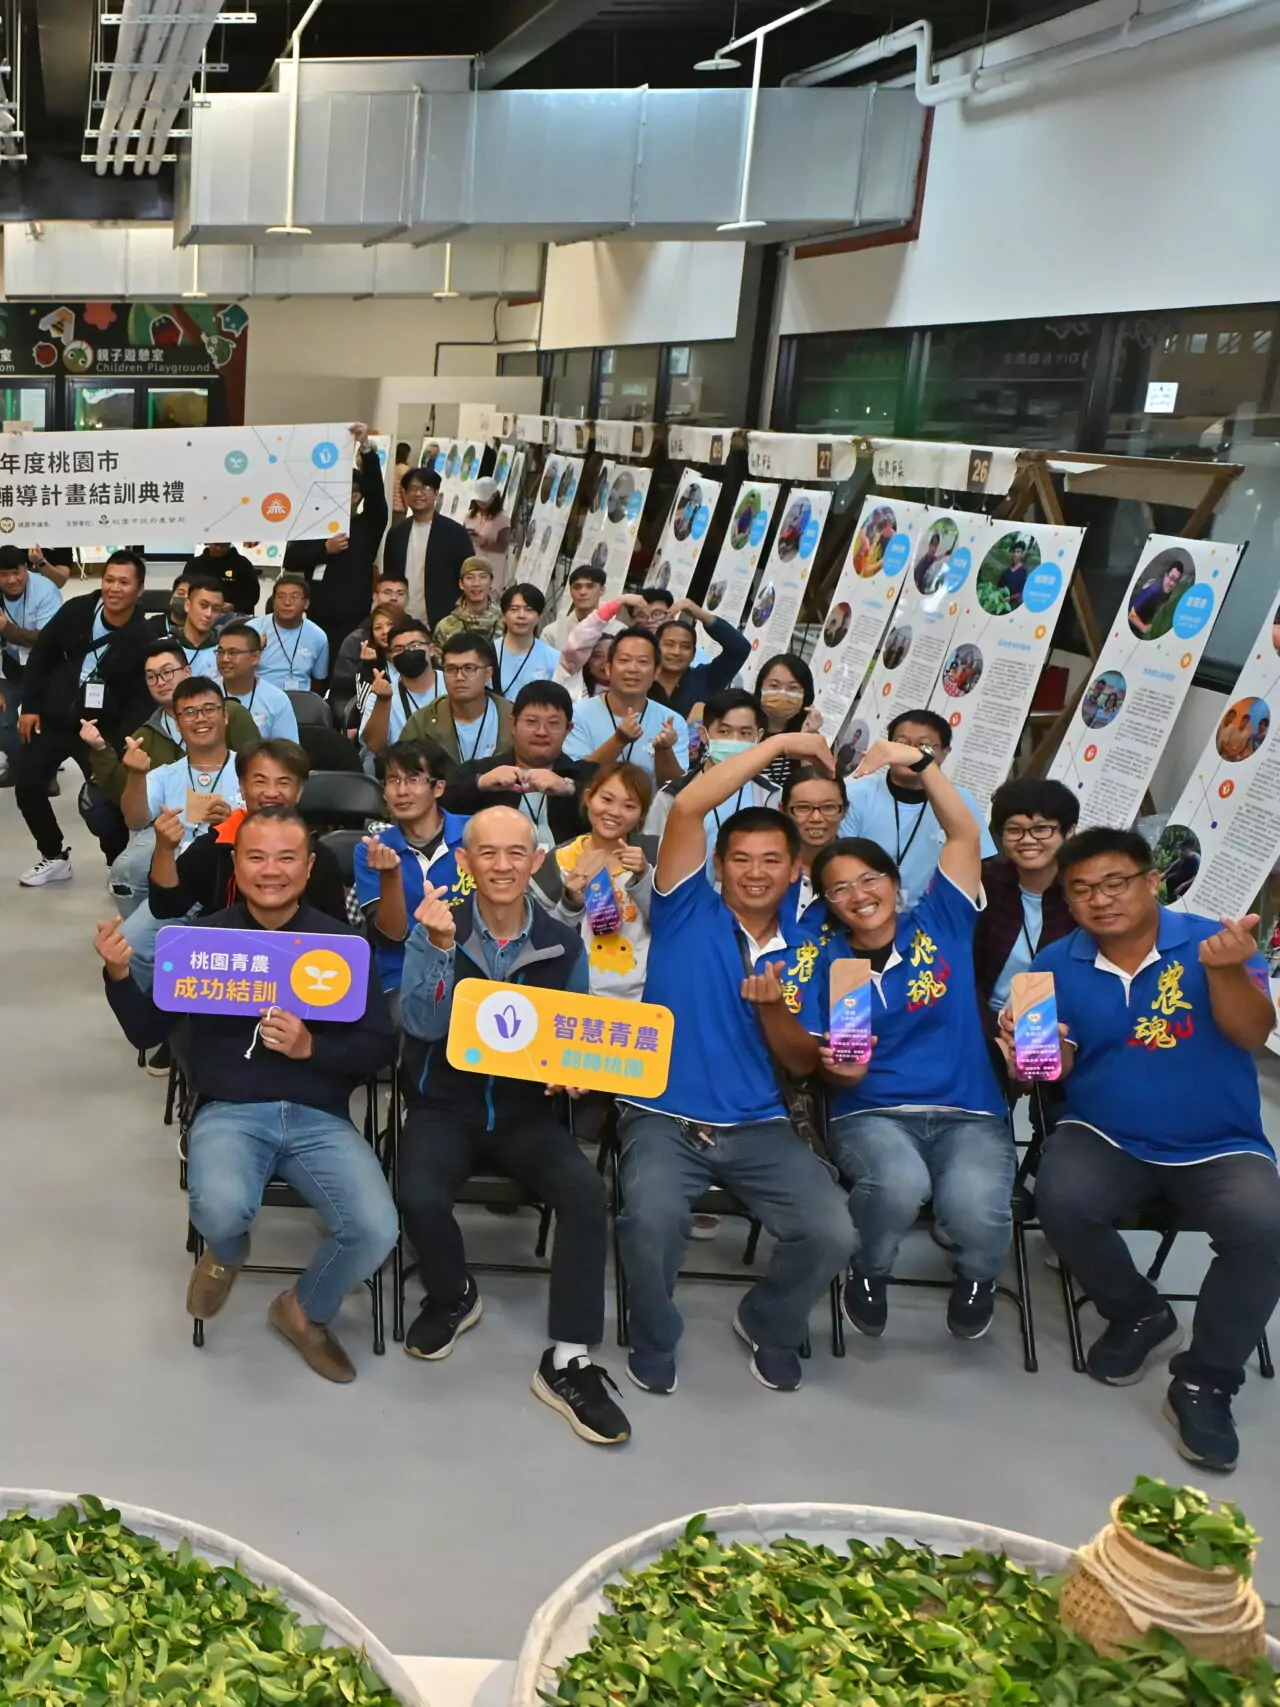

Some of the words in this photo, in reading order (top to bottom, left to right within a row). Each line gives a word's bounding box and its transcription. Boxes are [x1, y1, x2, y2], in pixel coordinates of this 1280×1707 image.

[96, 363, 143, 372] Children
[148, 362, 210, 375] Playground
[819, 450, 831, 470] 27
[971, 458, 989, 483] 26
[189, 951, 270, 974] 桃園青農
[173, 976, 277, 1004] 成功結訓
[553, 1013, 659, 1054] 智慧青農
